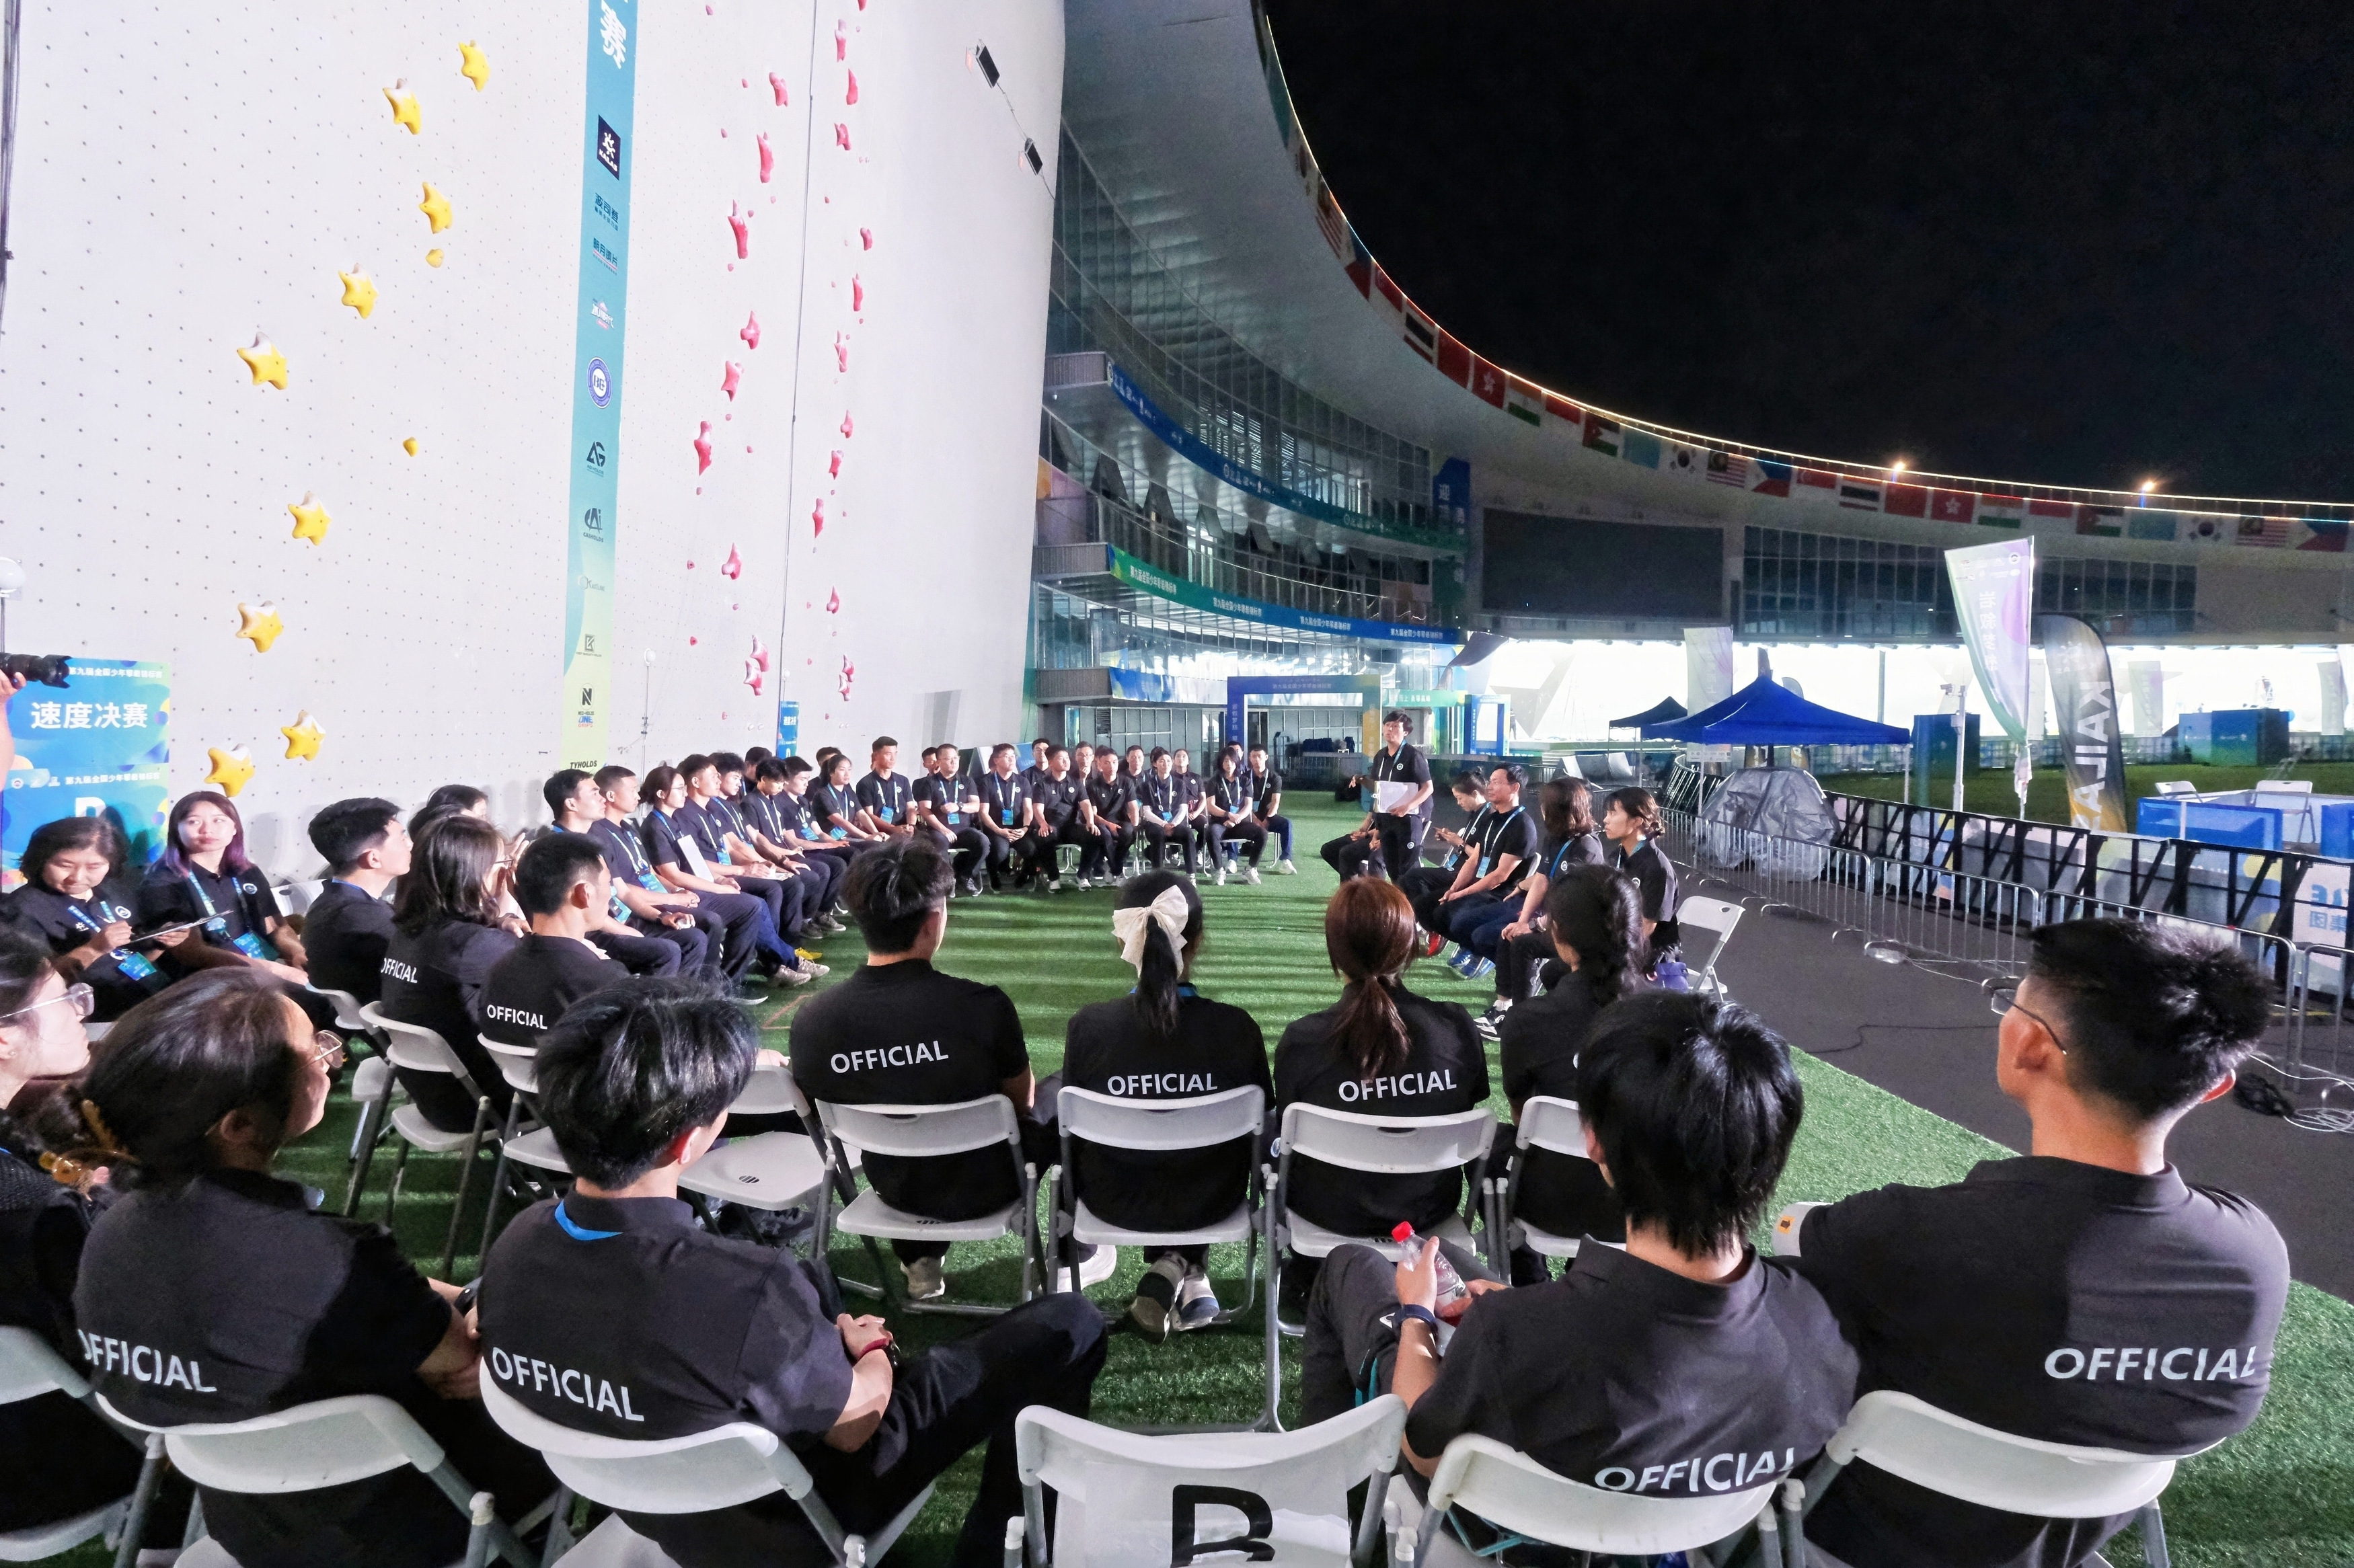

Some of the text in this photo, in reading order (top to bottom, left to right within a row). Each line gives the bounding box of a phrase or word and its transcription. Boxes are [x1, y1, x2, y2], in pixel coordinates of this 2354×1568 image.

[599, 149, 619, 173] KAILAS
[595, 192, 619, 224] 波司登
[582, 531, 604, 543] CAIHOLDS
[30, 701, 149, 730] 速度决赛
[570, 760, 598, 770] TYHOLDS
[486, 1004, 548, 1030] OFFICIAL
[831, 1040, 949, 1073] OFFICIAL
[1107, 1072, 1218, 1095] OFFICIAL
[1338, 1068, 1457, 1103] OFFICIAL
[2044, 1345, 2257, 1381] OFFICIAL
[492, 1346, 645, 1422] OFFICIAL
[1594, 1447, 1795, 1493] OFFICIAL
